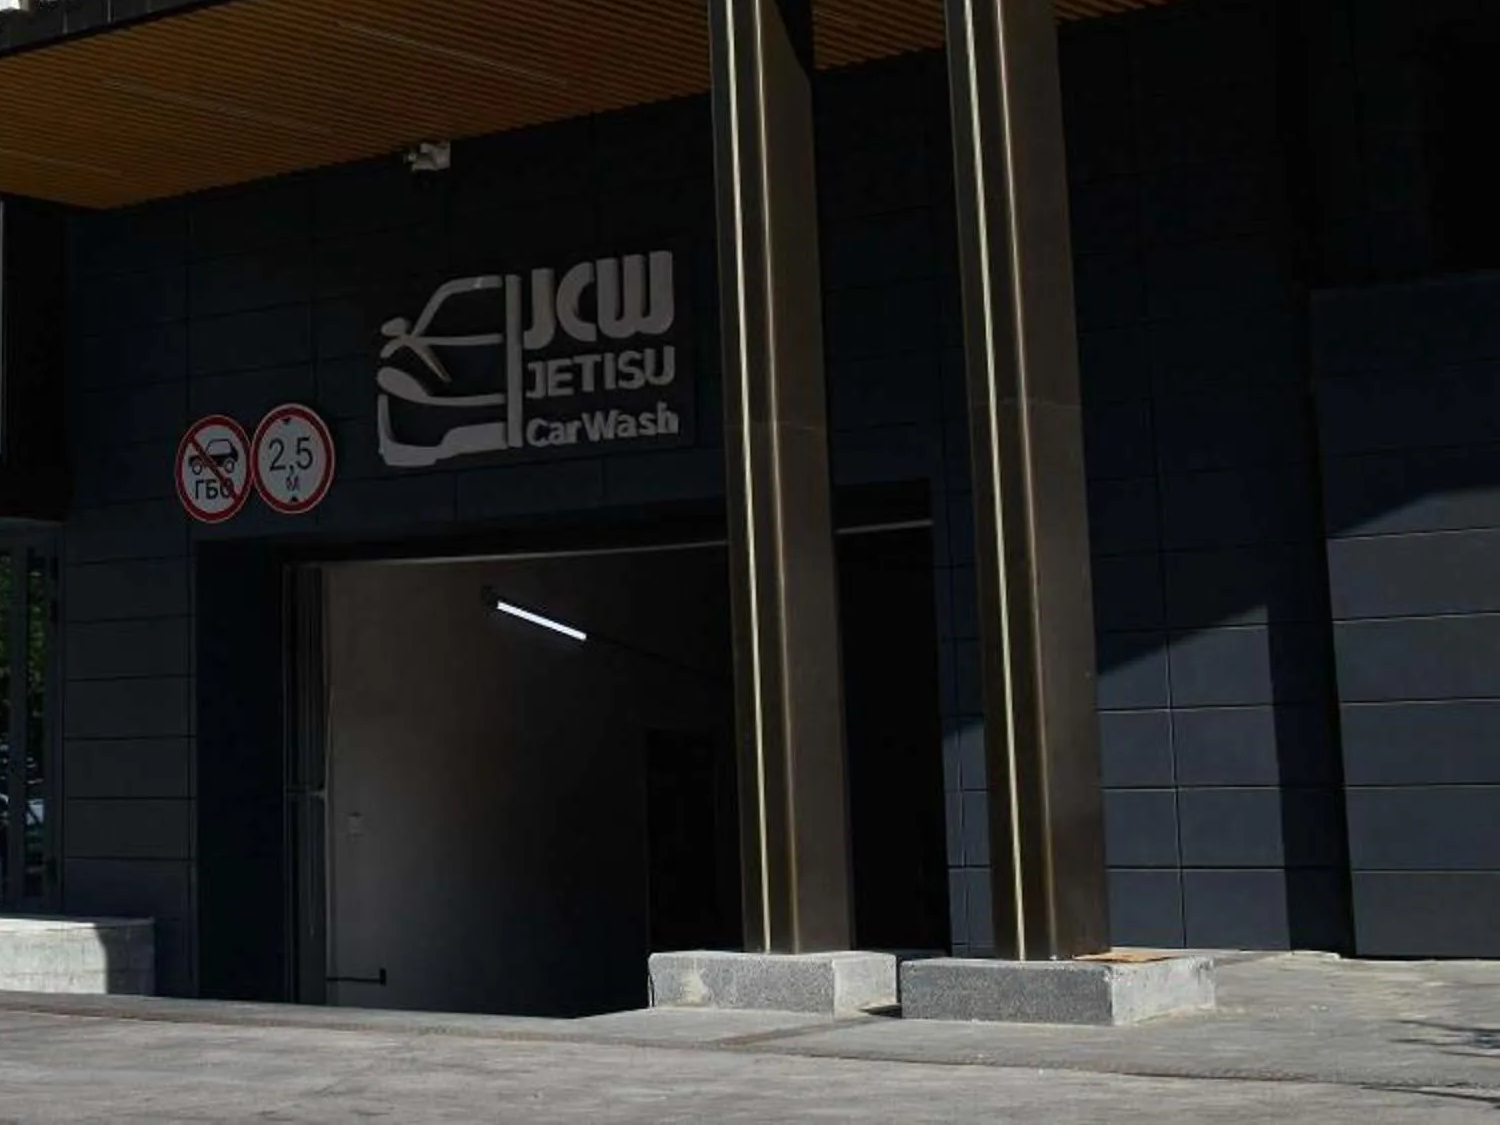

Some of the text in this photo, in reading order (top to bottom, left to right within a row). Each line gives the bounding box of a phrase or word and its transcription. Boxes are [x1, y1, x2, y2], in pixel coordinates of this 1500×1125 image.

[523, 251, 676, 350] JCW
[525, 345, 676, 399] JETISU
[268, 437, 314, 476] 2,5
